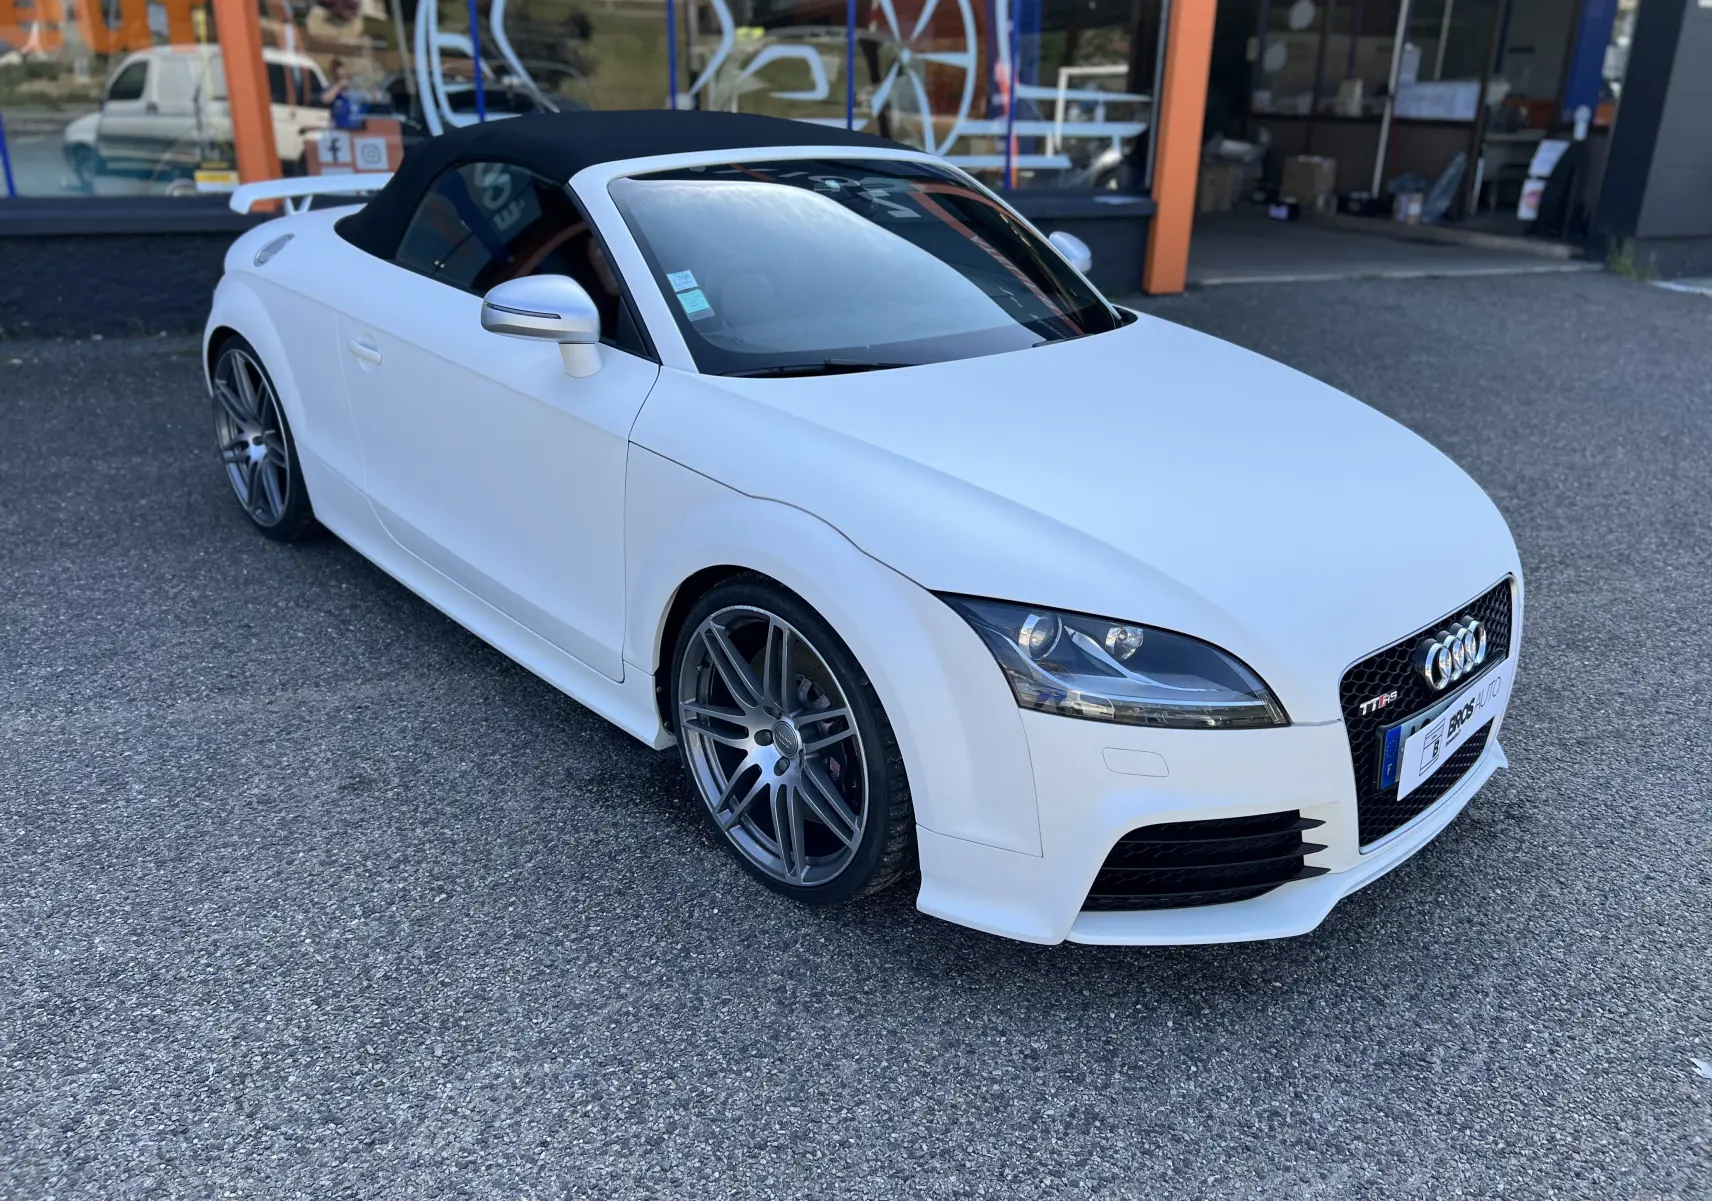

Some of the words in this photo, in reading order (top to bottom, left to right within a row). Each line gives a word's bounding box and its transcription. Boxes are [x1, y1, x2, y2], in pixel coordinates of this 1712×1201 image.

[1446, 697, 1476, 739] BROS
[1475, 676, 1502, 708] AUTO
[1386, 762, 1393, 776] F
